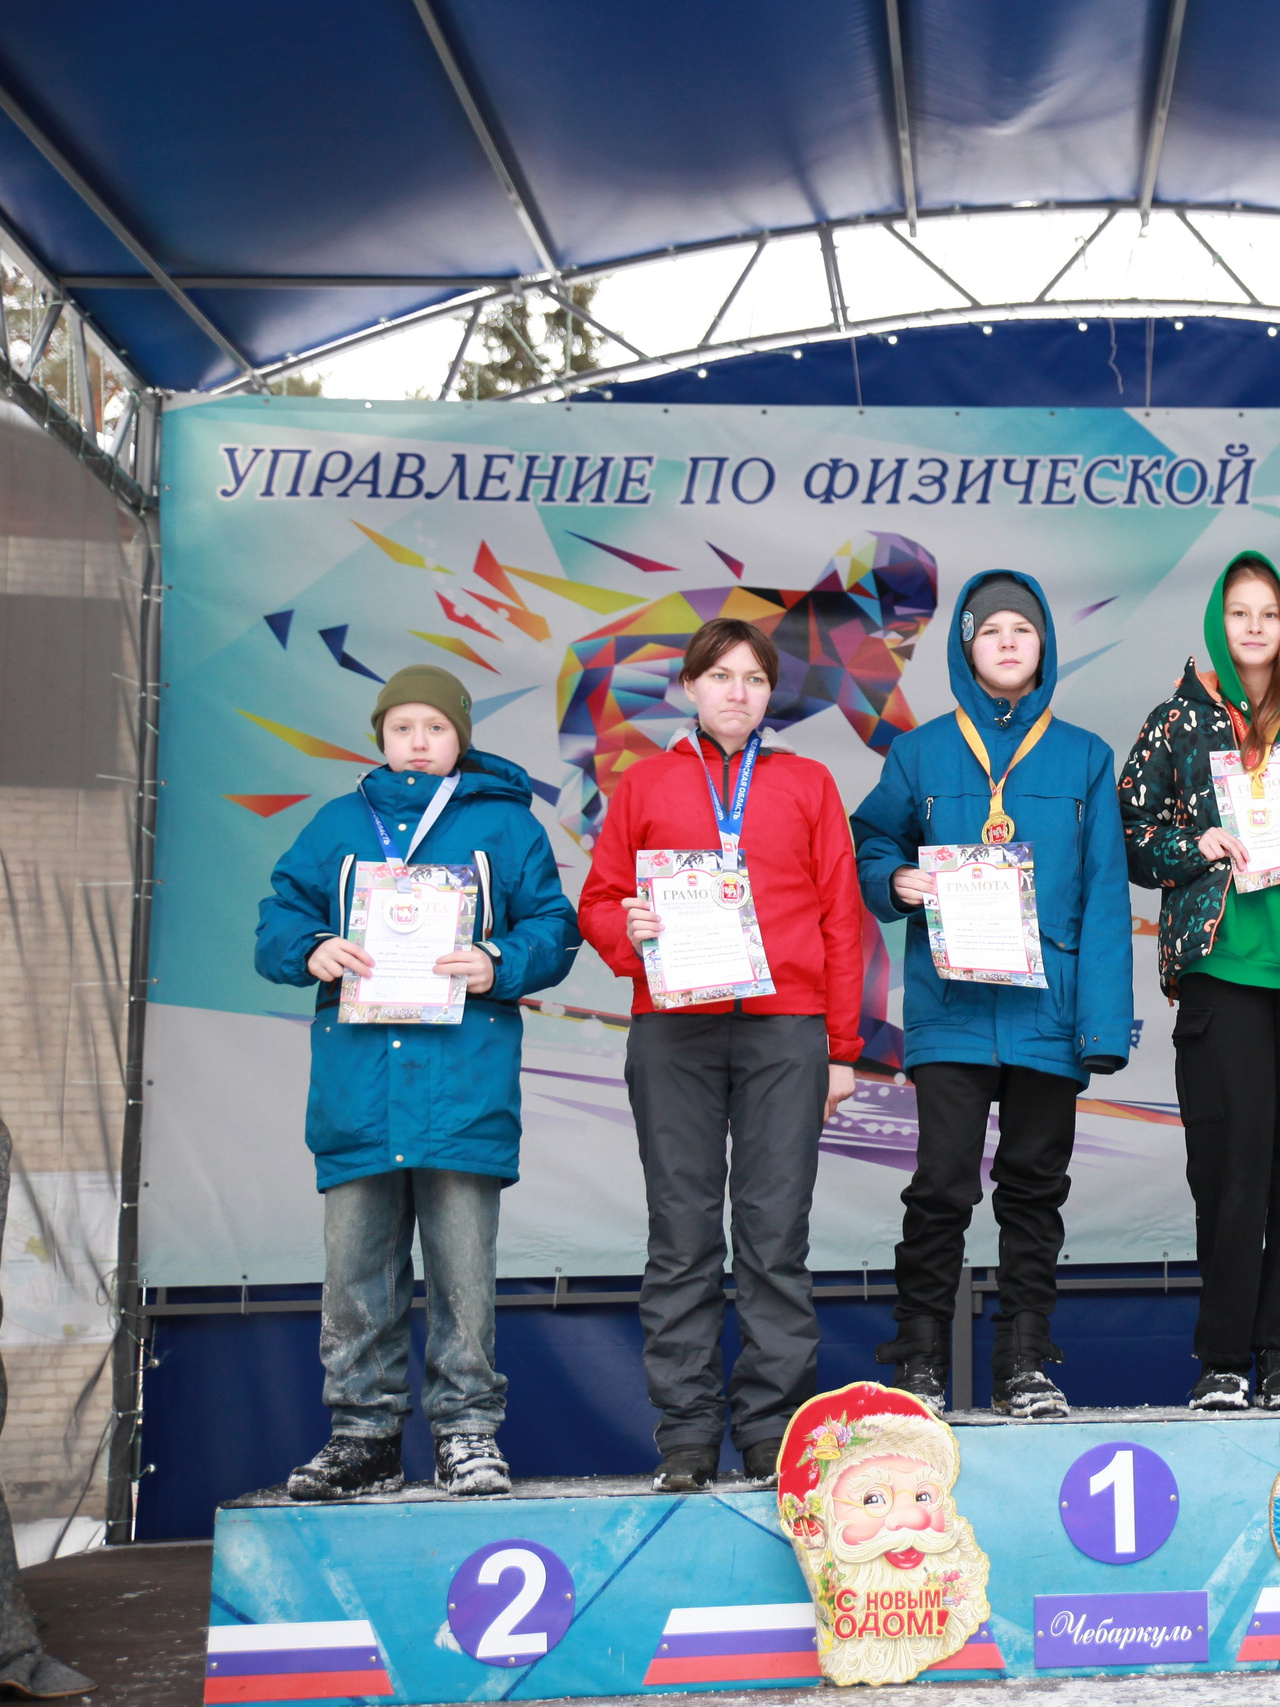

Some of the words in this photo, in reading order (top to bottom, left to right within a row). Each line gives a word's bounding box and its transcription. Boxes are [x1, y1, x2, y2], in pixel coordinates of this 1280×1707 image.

[218, 445, 655, 505] УПРАВЛЕНИЕ
[680, 457, 776, 505] ПО
[803, 444, 1255, 506] ФИЗИЧЕСКОЙ
[733, 787, 746, 820] ОБЛАСТЬ
[663, 888, 711, 901] ГРАМО
[947, 880, 1010, 893] ГРАМОТА
[1089, 1449, 1136, 1553] 1
[476, 1548, 548, 1658] 2
[836, 1588, 858, 1612] С
[866, 1589, 941, 1611] НОВЫМ
[1050, 1610, 1193, 1650] Чебаркуль
